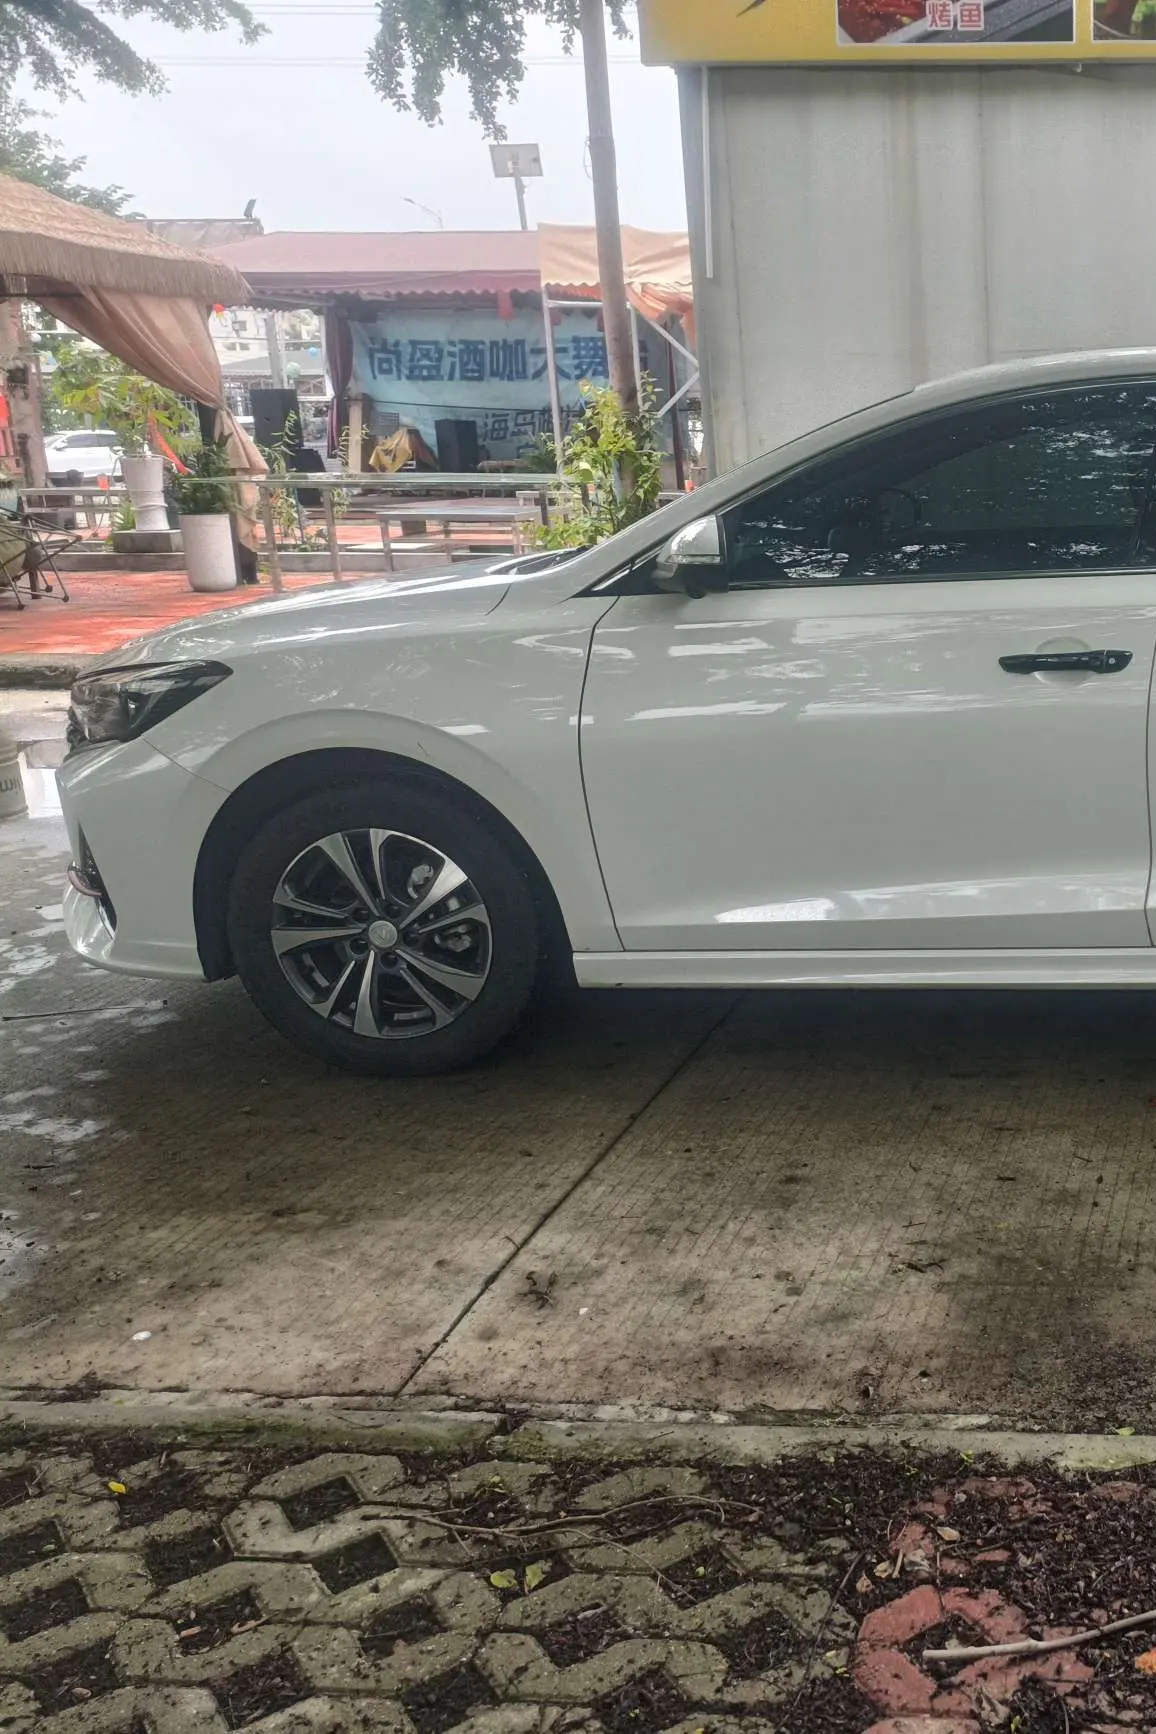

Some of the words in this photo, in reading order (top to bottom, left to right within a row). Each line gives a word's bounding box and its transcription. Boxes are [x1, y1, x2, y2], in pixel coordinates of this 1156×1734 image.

[926, 1, 985, 30] 烤鱼
[367, 335, 649, 382] 尚盈酒咖大舞
